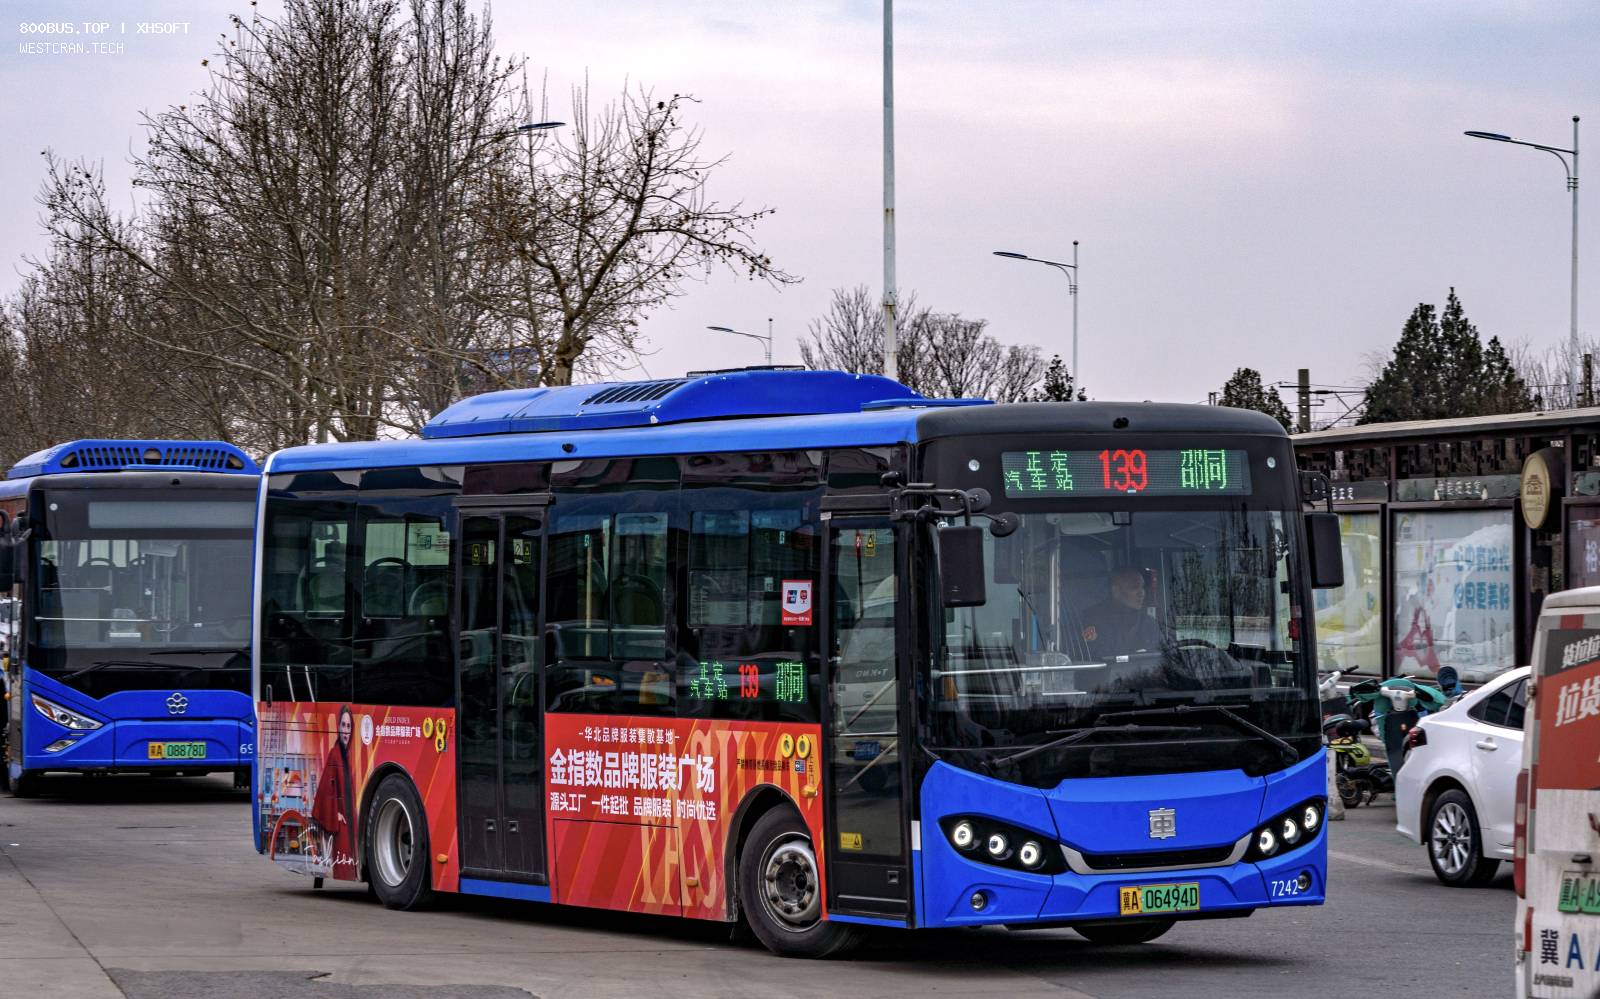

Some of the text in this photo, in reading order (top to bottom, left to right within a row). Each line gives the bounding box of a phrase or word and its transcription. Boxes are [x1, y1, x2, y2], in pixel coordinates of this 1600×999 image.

[1026, 450, 1068, 471] 正定
[1099, 449, 1148, 491] 139
[1005, 470, 1073, 491] 汽车站
[699, 660, 723, 681] 正定
[690, 680, 728, 700] 汽车站
[738, 664, 759, 699] 139
[550, 747, 715, 793] 金指数品牌服装广场
[550, 792, 716, 820] 源头工厂 一件起批 品牌服装 时尚优选
[1272, 879, 1298, 896] 7242
